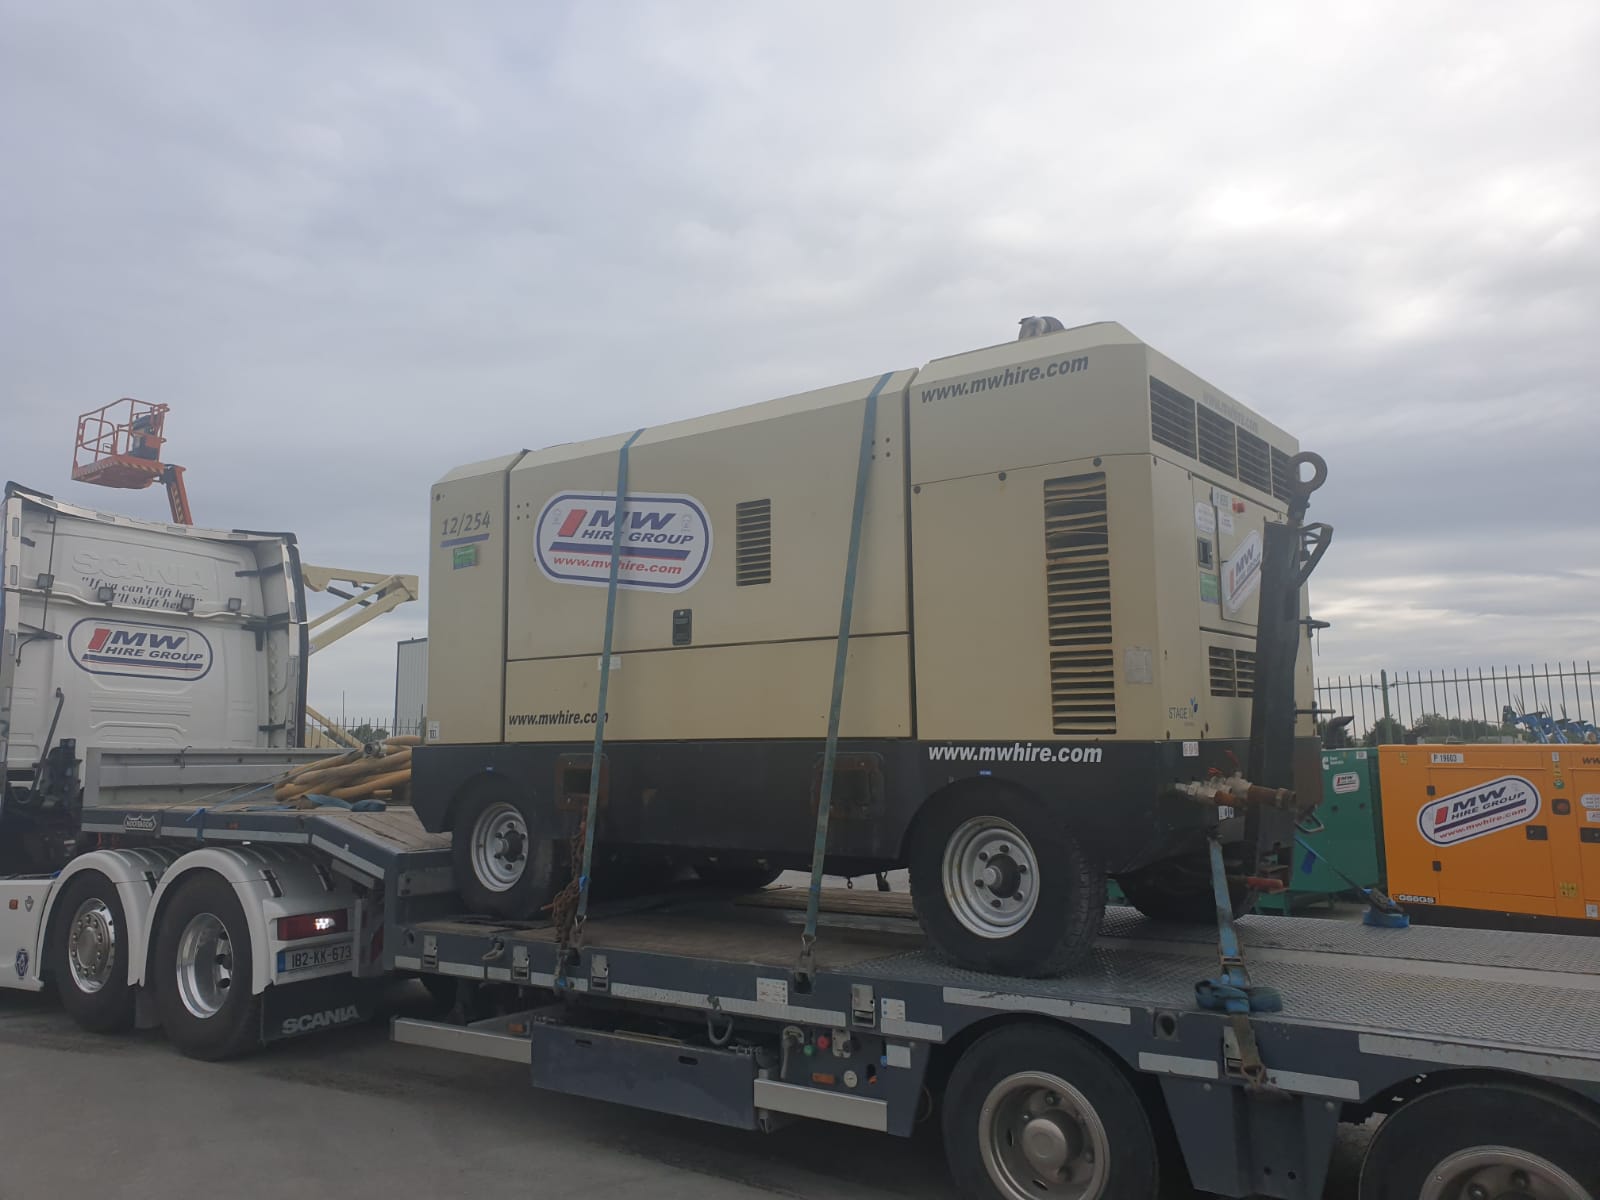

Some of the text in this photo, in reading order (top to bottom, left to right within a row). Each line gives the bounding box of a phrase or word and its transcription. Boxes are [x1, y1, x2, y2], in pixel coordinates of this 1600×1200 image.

[921, 355, 1089, 403] www.mwhire.com
[441, 511, 490, 536] 12/254
[587, 509, 676, 531] MW
[581, 529, 694, 545] HIR GROUP
[111, 630, 186, 650] MW
[104, 646, 204, 662] HIRE GROUP
[508, 710, 609, 726] www.mwhire.co
[928, 742, 1103, 763] www.mwhire.com
[1451, 791, 1526, 821] HIRE GROUP
[1452, 786, 1506, 813] MW
[291, 945, 352, 969] 182-KK-673
[281, 1004, 360, 1034] SCANIA
